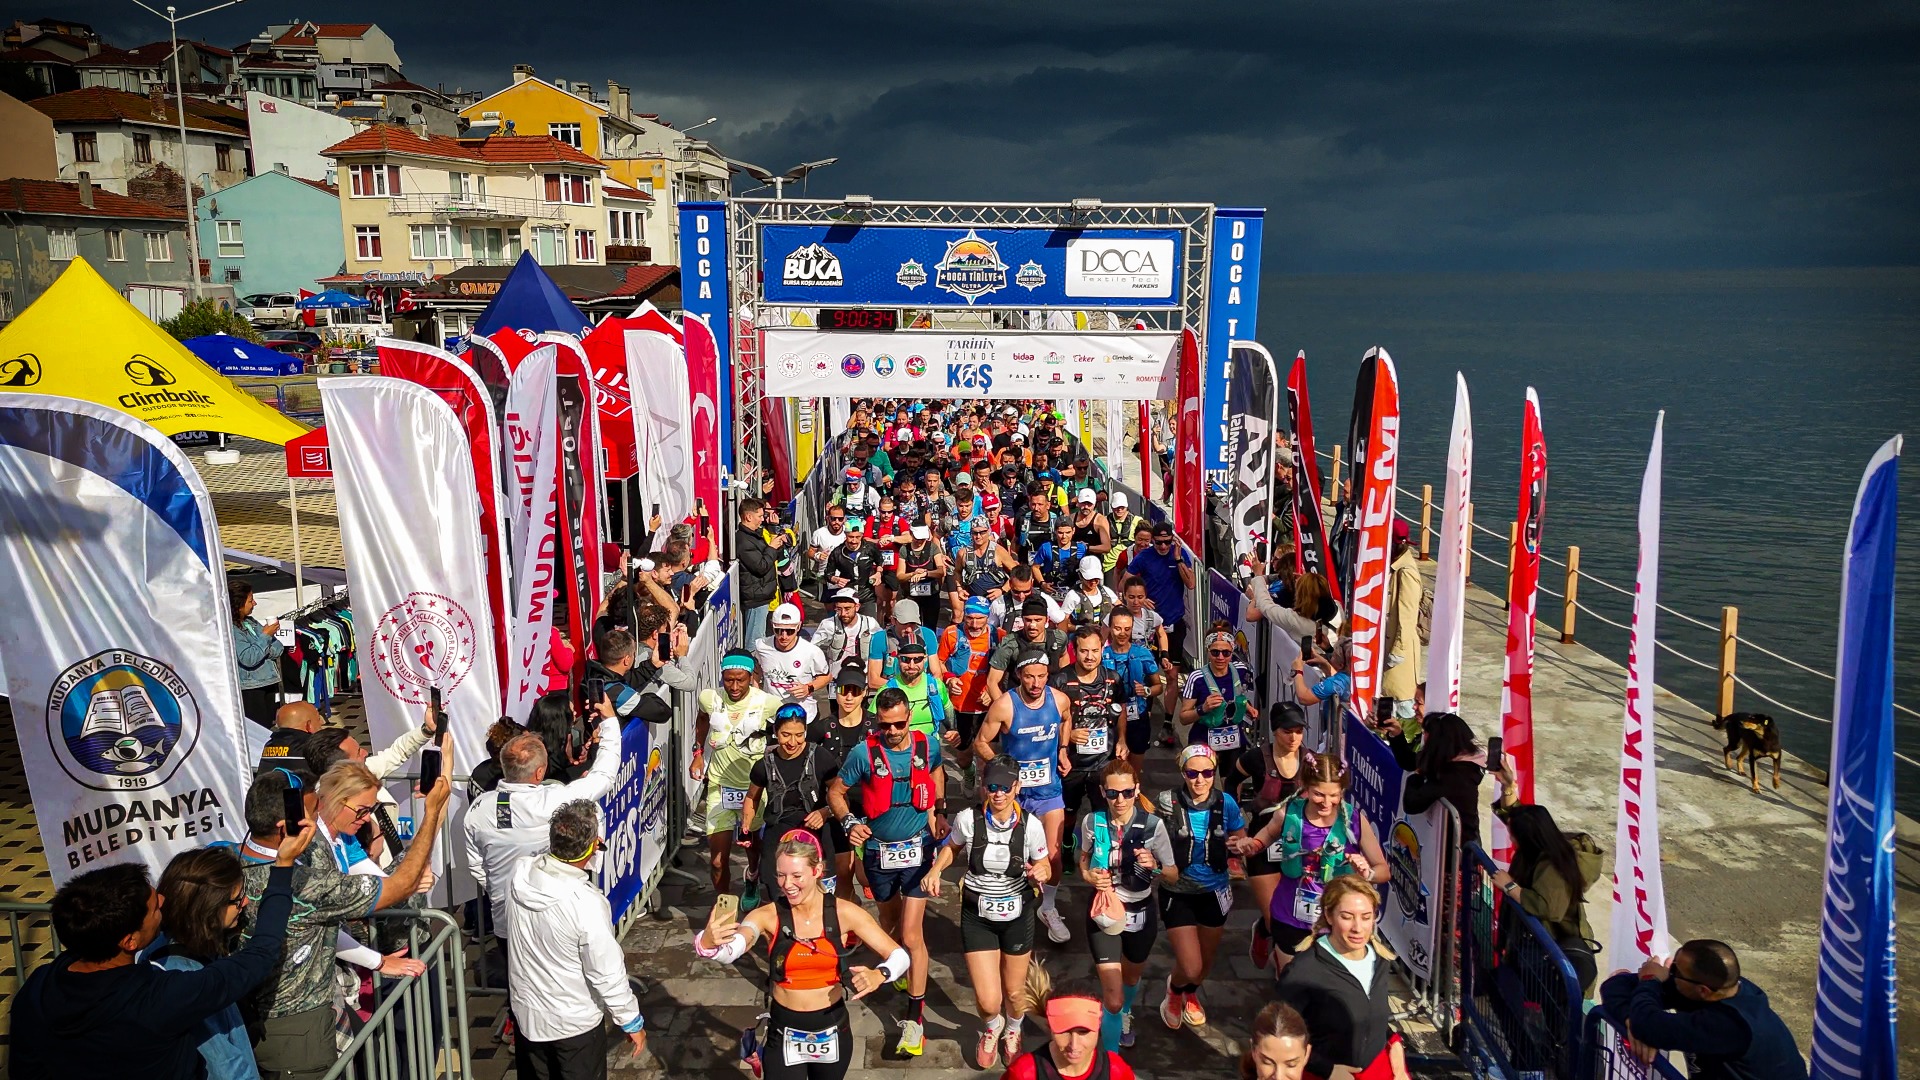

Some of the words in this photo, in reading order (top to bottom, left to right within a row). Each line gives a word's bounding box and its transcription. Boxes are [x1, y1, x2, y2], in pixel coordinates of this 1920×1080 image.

[696, 215, 711, 299] DOCA
[1080, 249, 1158, 273] DOCA
[1227, 221, 1246, 305] DOCA
[783, 259, 843, 280] BUKA
[946, 272, 966, 282] DOCA
[969, 270, 998, 282] TİRİLYE
[834, 311, 893, 328] 9:00:34
[947, 337, 996, 350] TARİHİN
[946, 351, 996, 361] İZİNDE
[1013, 353, 1035, 361] bidaa
[946, 363, 993, 395] KOŞ
[118, 388, 216, 409] Climbolic
[142, 403, 178, 412] OUTDOOR
[51, 658, 106, 712] MUDANYA
[113, 653, 189, 699] BELEDİYESİ
[1213, 734, 1237, 745] 339
[1020, 769, 1046, 780] 395
[1351, 745, 1384, 797] TARİHİN
[117, 777, 148, 788] 1919
[727, 791, 744, 802] 39
[62, 787, 222, 847] MUDANYA
[67, 812, 225, 870] BELEDİYESİ
[888, 849, 917, 862] 266
[985, 901, 1016, 913] 258
[1302, 904, 1321, 918] 15
[793, 1042, 830, 1054] 105
